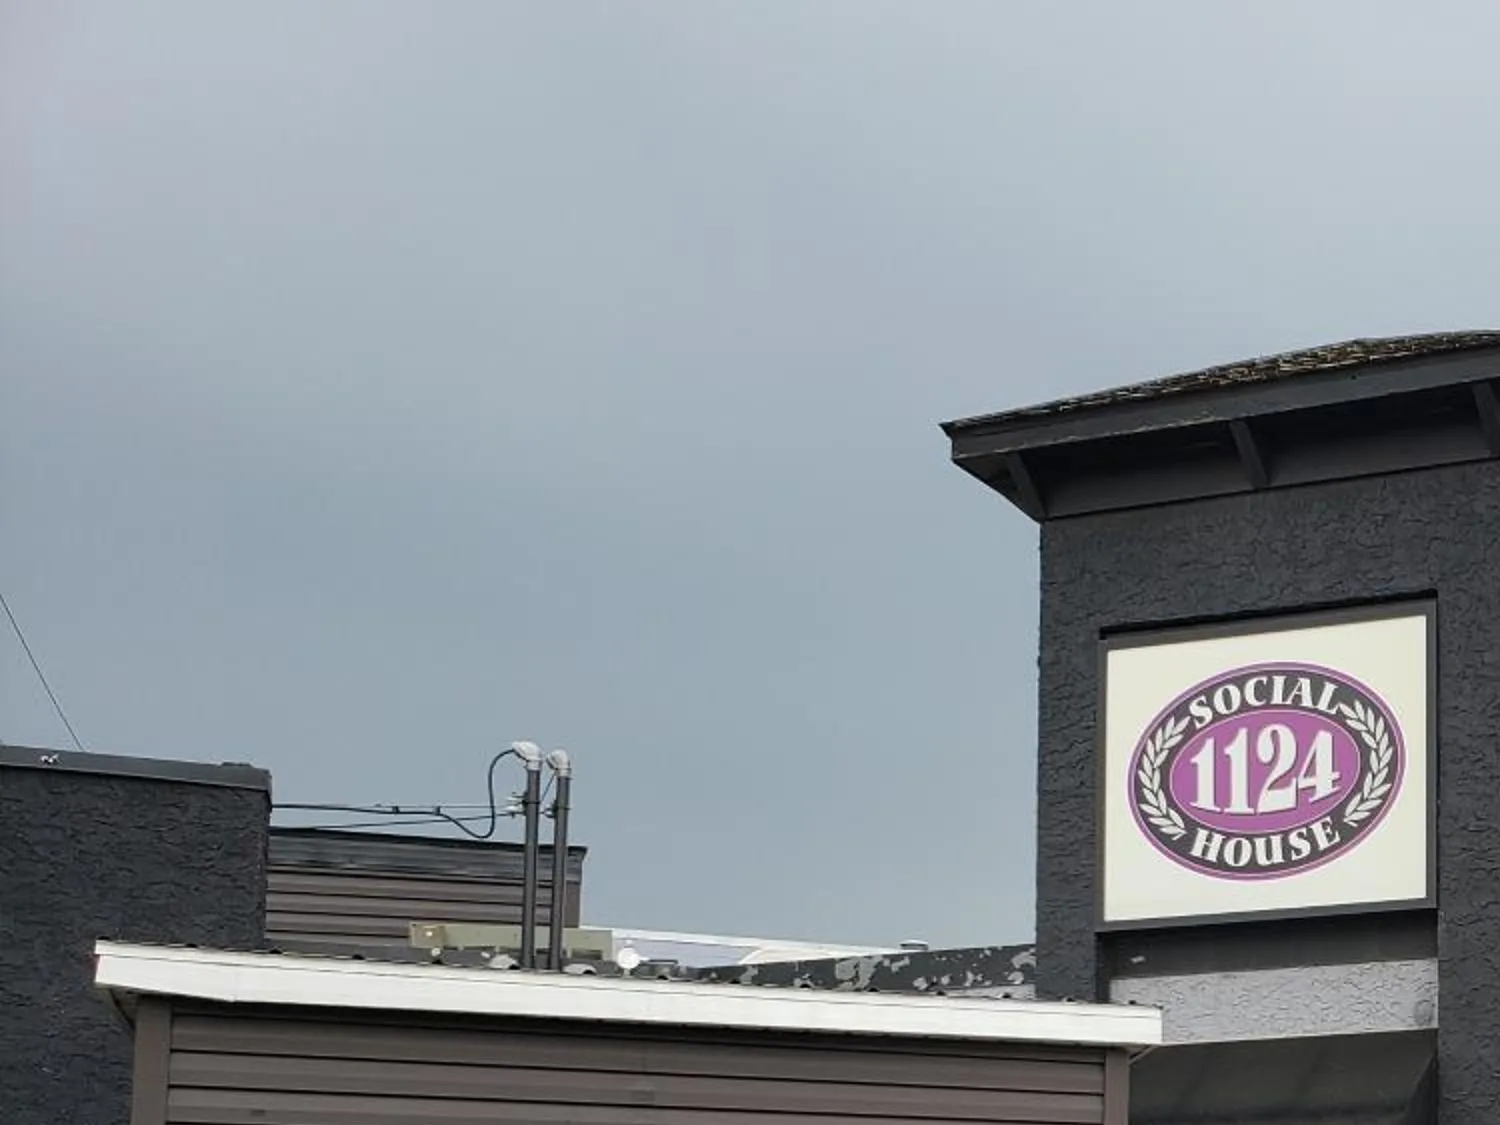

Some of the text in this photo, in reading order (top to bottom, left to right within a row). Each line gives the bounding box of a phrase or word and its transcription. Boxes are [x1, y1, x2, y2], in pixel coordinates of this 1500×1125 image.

[1189, 676, 1339, 729] SOCIAL
[1190, 723, 1341, 816] 1124
[1189, 816, 1341, 867] HOUSE
